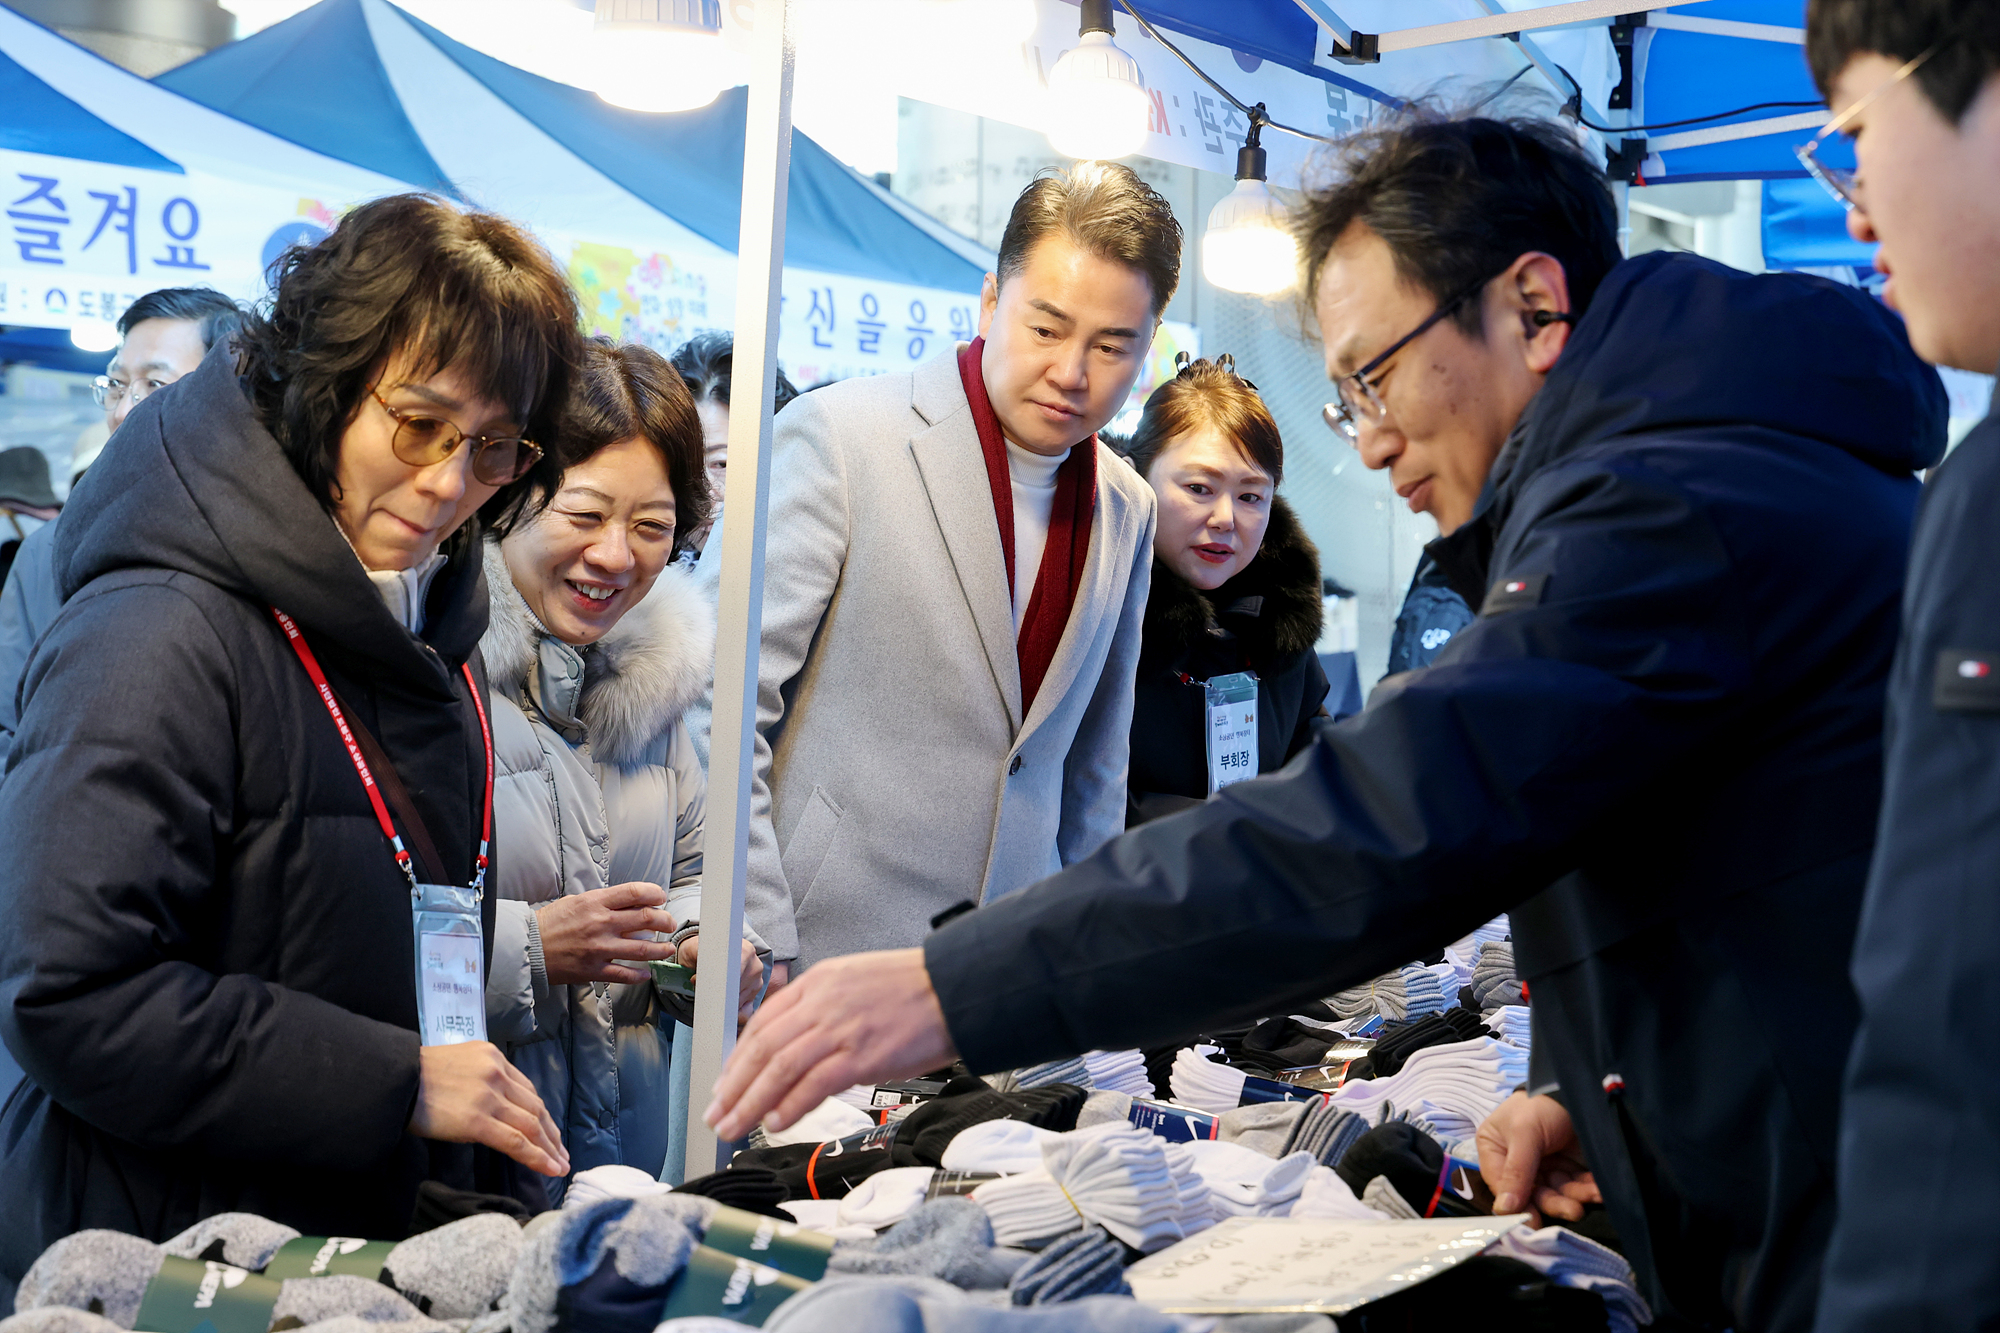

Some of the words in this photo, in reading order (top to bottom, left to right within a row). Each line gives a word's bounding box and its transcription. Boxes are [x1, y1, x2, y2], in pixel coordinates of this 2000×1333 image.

[6, 172, 211, 275] 즐겨요
[1220, 749, 1250, 770] 부회장
[436, 1014, 475, 1036] 사무국장
